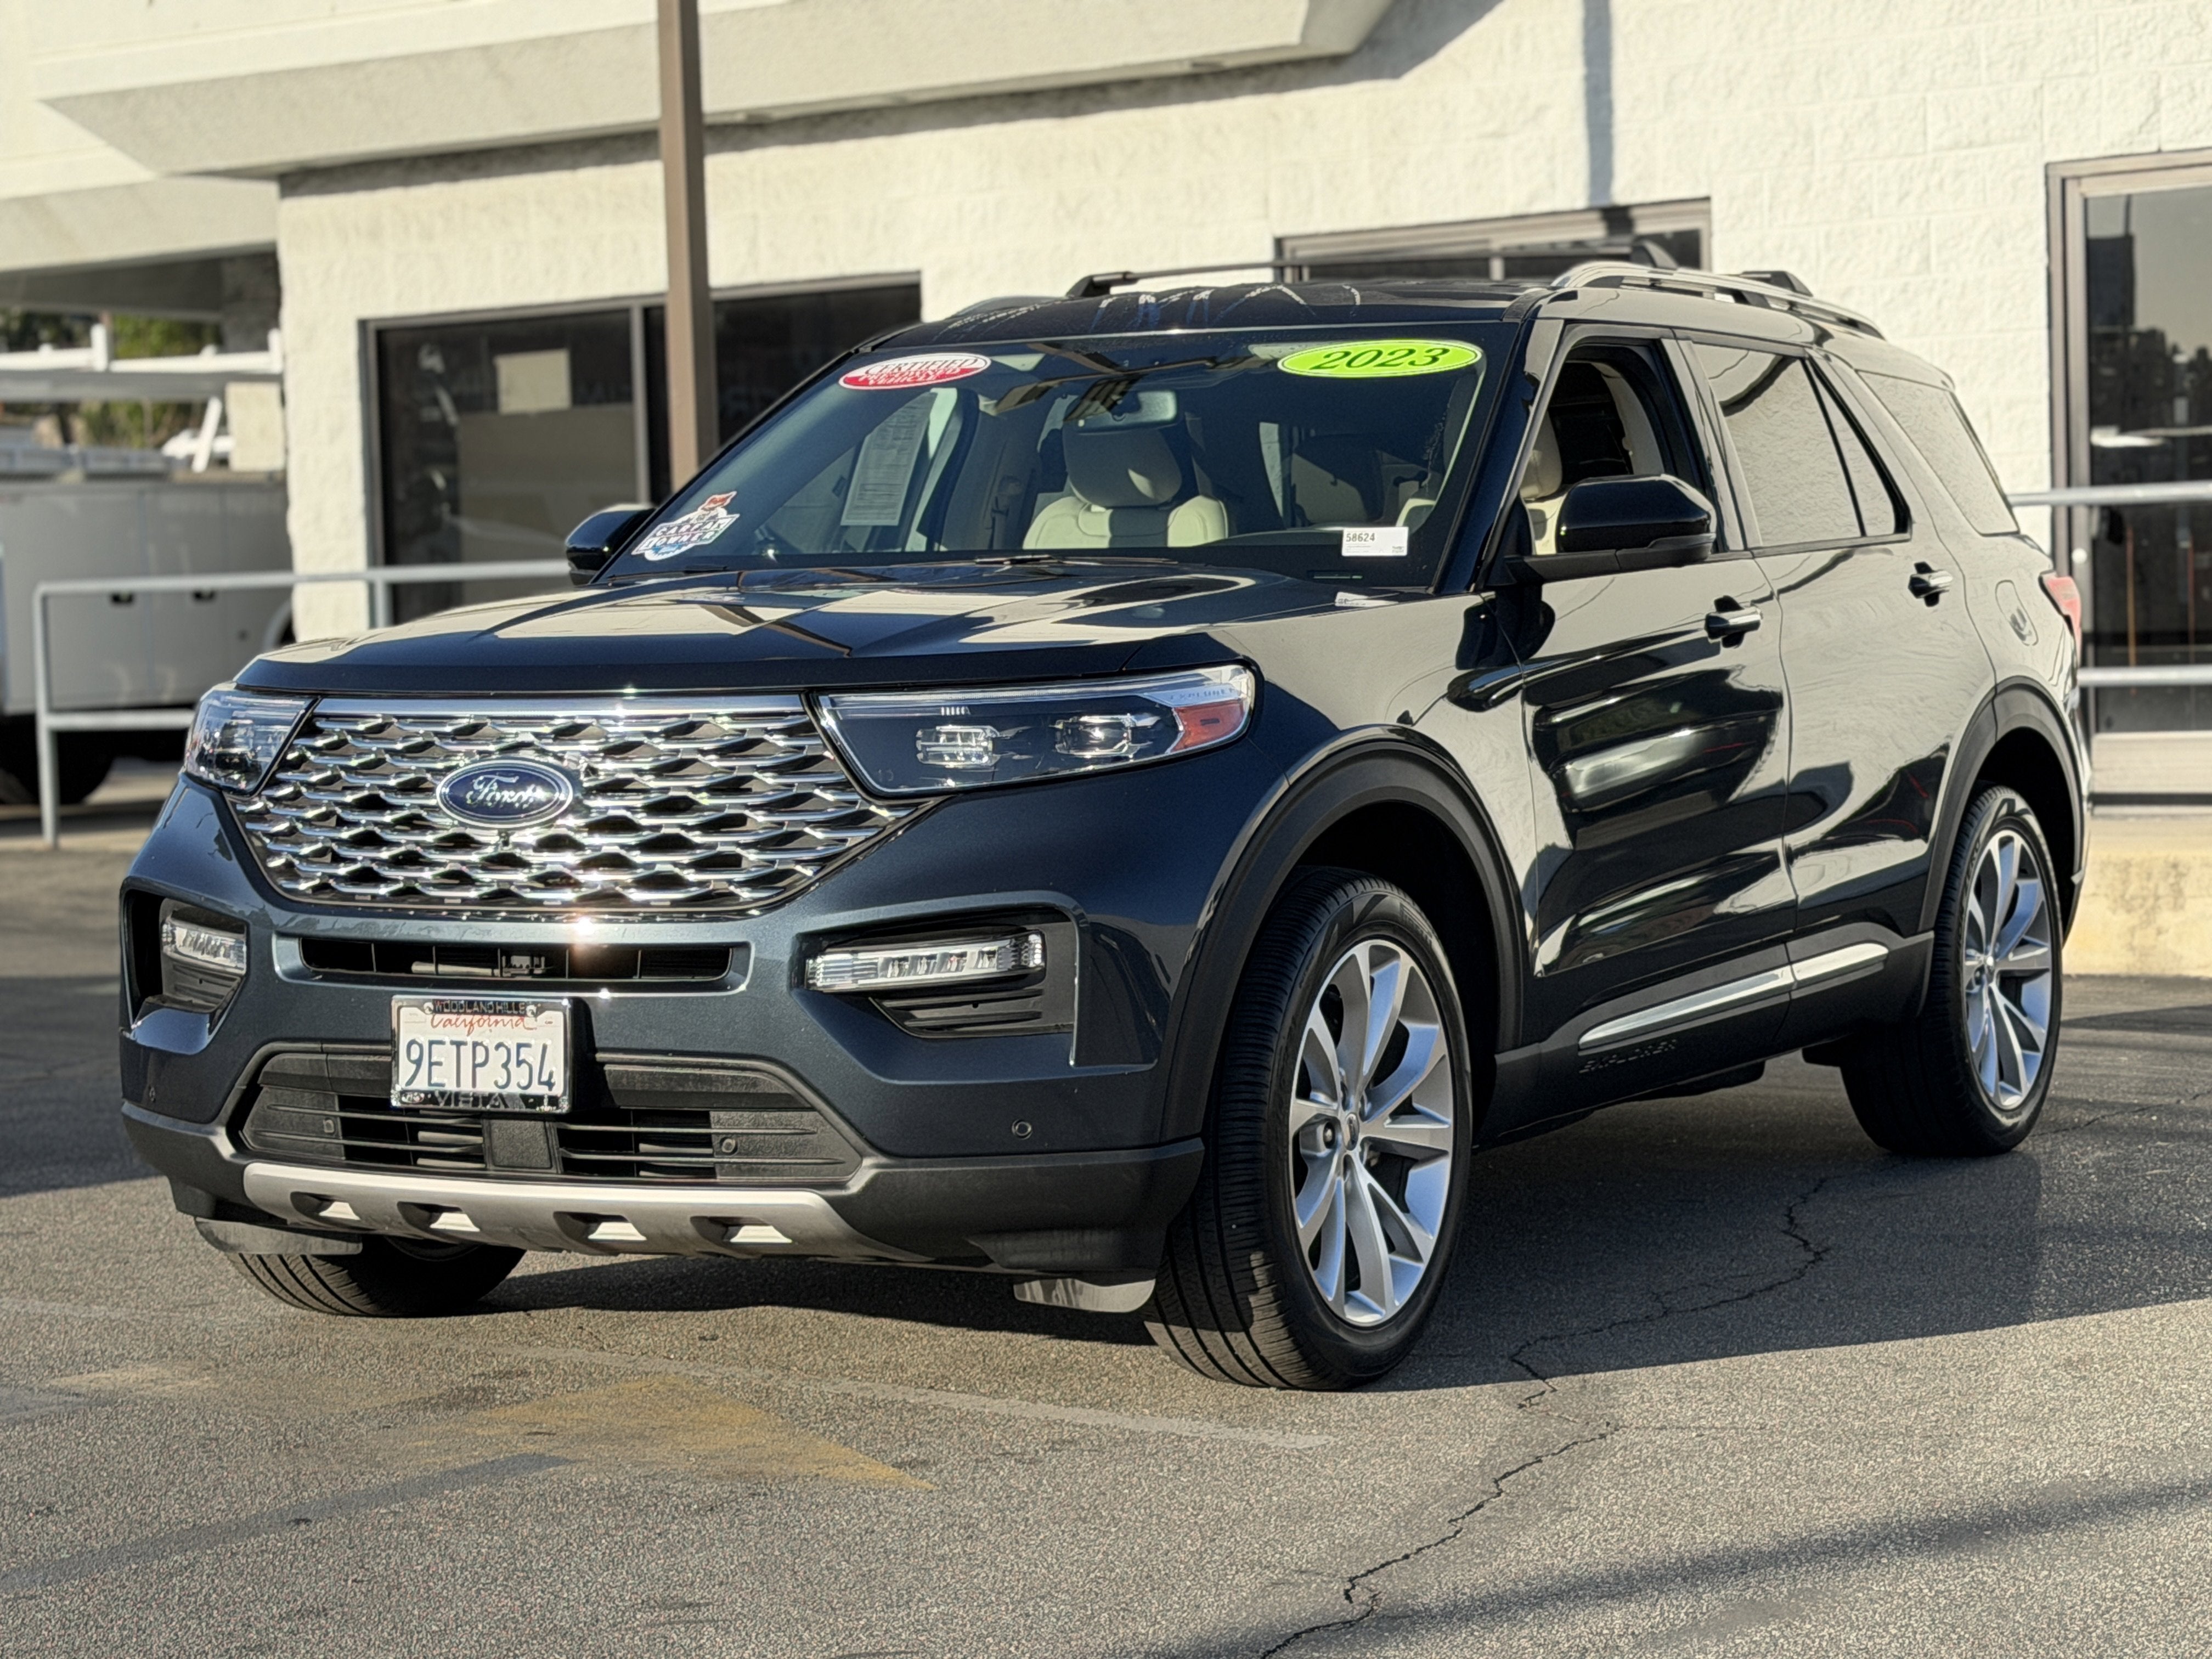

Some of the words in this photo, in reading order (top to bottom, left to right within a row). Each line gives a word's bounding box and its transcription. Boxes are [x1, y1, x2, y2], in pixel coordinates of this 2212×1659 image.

[865, 358, 979, 375] CERTIFIED
[1309, 348, 1451, 370] 2023
[656, 519, 727, 537] CARFAX
[1346, 533, 1375, 542] 58624
[656, 531, 715, 546] OWNER
[466, 775, 549, 808] Ford
[431, 1014, 538, 1037] California
[405, 1038, 556, 1092] 9ETP354
